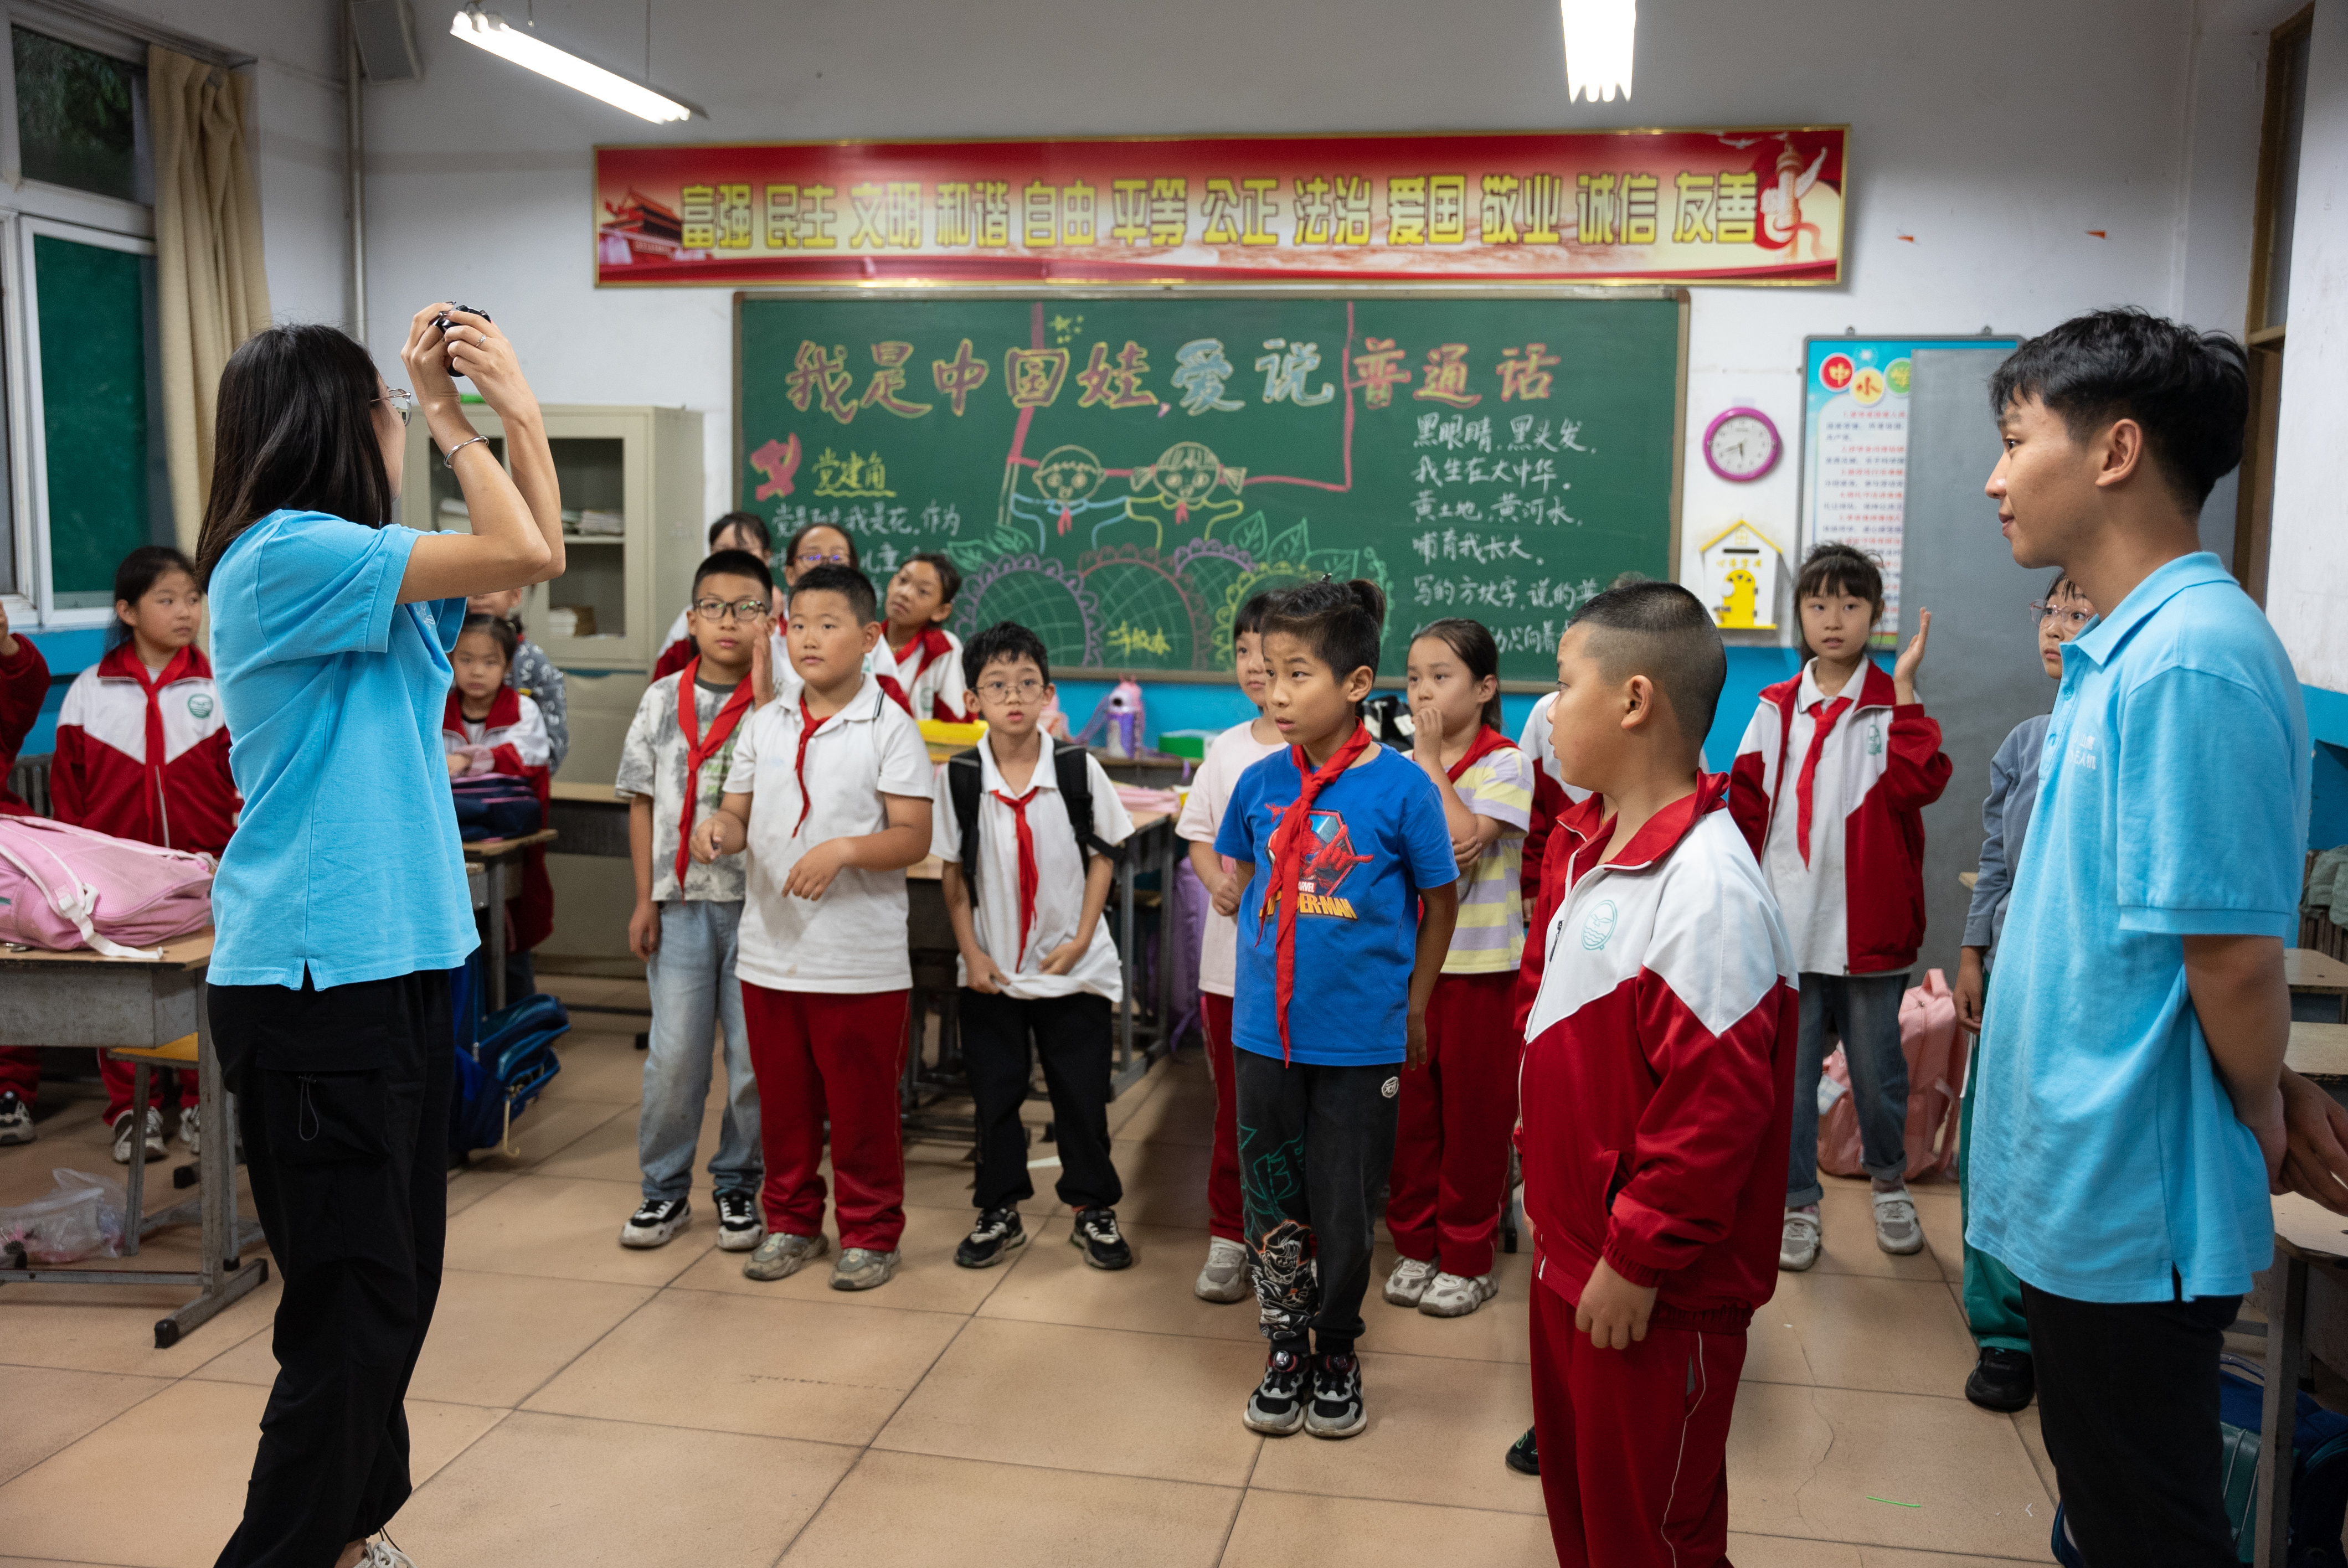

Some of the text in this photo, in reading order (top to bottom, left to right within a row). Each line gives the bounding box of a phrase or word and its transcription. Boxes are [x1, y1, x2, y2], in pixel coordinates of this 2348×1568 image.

[681, 171, 1759, 249] 富强 民主 文明 和谐 自由 平等 公正 法治 爱国 敬业 诚信 友善
[811, 446, 885, 491] 党建角
[1298, 881, 1315, 893] ARVEL
